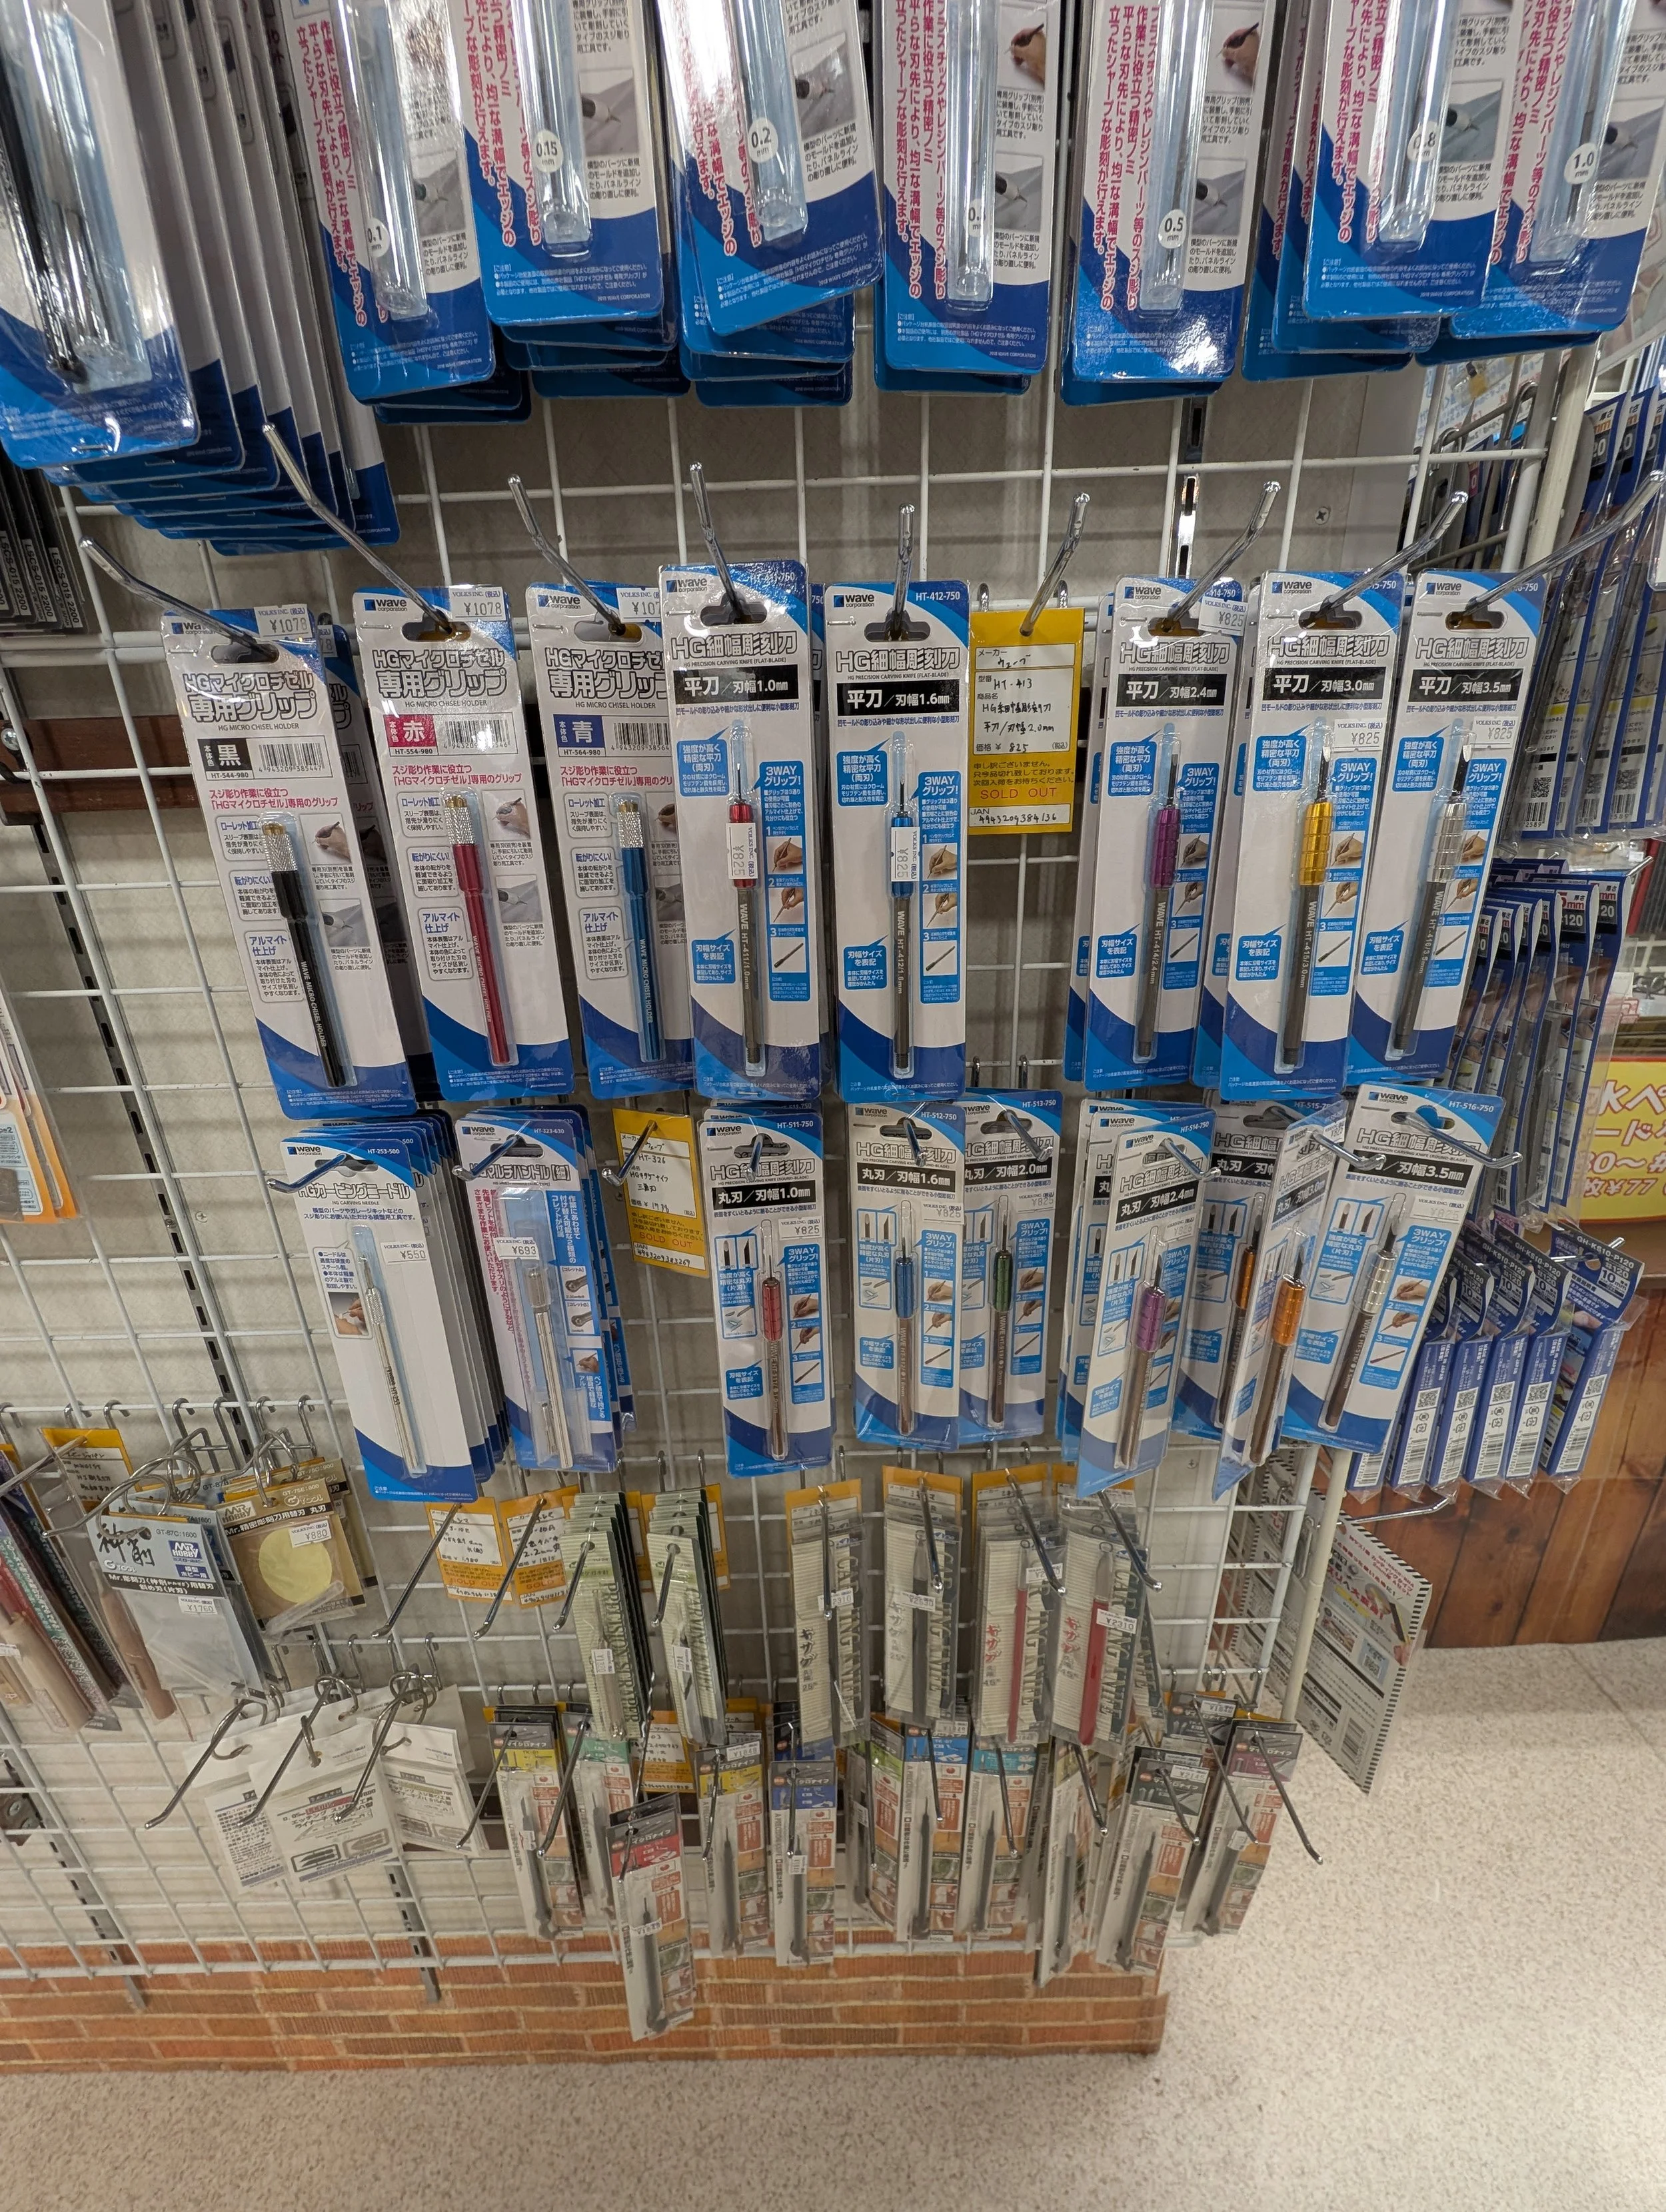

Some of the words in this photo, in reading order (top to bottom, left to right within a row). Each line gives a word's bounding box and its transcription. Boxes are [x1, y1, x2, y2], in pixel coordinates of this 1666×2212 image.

[751, 127, 772, 148] 0.2
[536, 141, 558, 157] 0.15
[757, 147, 769, 157] mm
[1573, 151, 1595, 169] 1.0
[1164, 218, 1184, 232] 0.5
[916, 592, 960, 601] HT-412-750
[67, 601, 79, 624] 2200
[464, 602, 502, 616] ¥1078
[1219, 612, 1244, 626] ¥825
[270, 618, 308, 634] ¥1078
[671, 630, 797, 660] HG細幅彫刻刀
[372, 648, 505, 669] HGマイクロチゼル
[1119, 642, 1230, 664] HG細幅彫刻刀
[836, 647, 960, 672] HG細幅彫刻刀
[183, 672, 315, 692] HGマイクロチゼル
[377, 670, 508, 699] 専用グリップ
[191, 692, 319, 722] 専用グリップ
[402, 720, 426, 742] 赤
[572, 721, 594, 743] 青
[1487, 727, 1513, 740] ¥825
[1351, 732, 1379, 745] ¥825
[682, 744, 720, 753] 強度が高く
[1009, 743, 1028, 752] 825
[1116, 746, 1150, 755] 強度が高く
[1403, 741, 1437, 750] 強度が高く
[219, 744, 241, 767] 黒
[683, 753, 722, 763] 精密な平刀
[1115, 755, 1150, 764] 精密な平刀
[392, 765, 472, 776] スジ彫り作業に役立つ
[559, 766, 638, 776] スジ彫り作業に役立つ
[766, 766, 797, 776] 3WAY
[843, 764, 881, 773] 精密な平刀
[1188, 768, 1214, 776] 3WAY
[1340, 763, 1371, 772] 3WAY
[1472, 763, 1501, 772] 3WAY
[924, 777, 954, 786] 3WAY
[209, 788, 289, 800] スジ彫り作業に役立つ
[980, 789, 1018, 800] SOLD
[1029, 787, 1056, 798] OUT
[733, 845, 744, 876] ¥825
[897, 848, 908, 877] ¥825
[422, 912, 460, 922] アルマイト
[583, 913, 619, 922] アルマイト
[1308, 901, 1317, 928] WAVE
[425, 923, 450, 933] 仕上げ
[249, 935, 287, 945] アルマイト
[251, 946, 277, 956] 仕上げ
[1022, 1099, 1056, 1108] HT-513-750
[1449, 1100, 1494, 1113] HT-516-750
[921, 1111, 957, 1121] HT-512-750
[777, 1121, 814, 1129] HT-511-750
[937, 1209, 961, 1219] ¥825
[795, 1225, 820, 1236] ¥825
[1413, 1229, 1446, 1239] 3WAY
[639, 1233, 665, 1243] SOLD
[672, 1239, 692, 1248] OUT
[400, 1249, 426, 1260] ¥550
[512, 1245, 536, 1256] ¥693
[305, 1528, 328, 1540] ¥880
